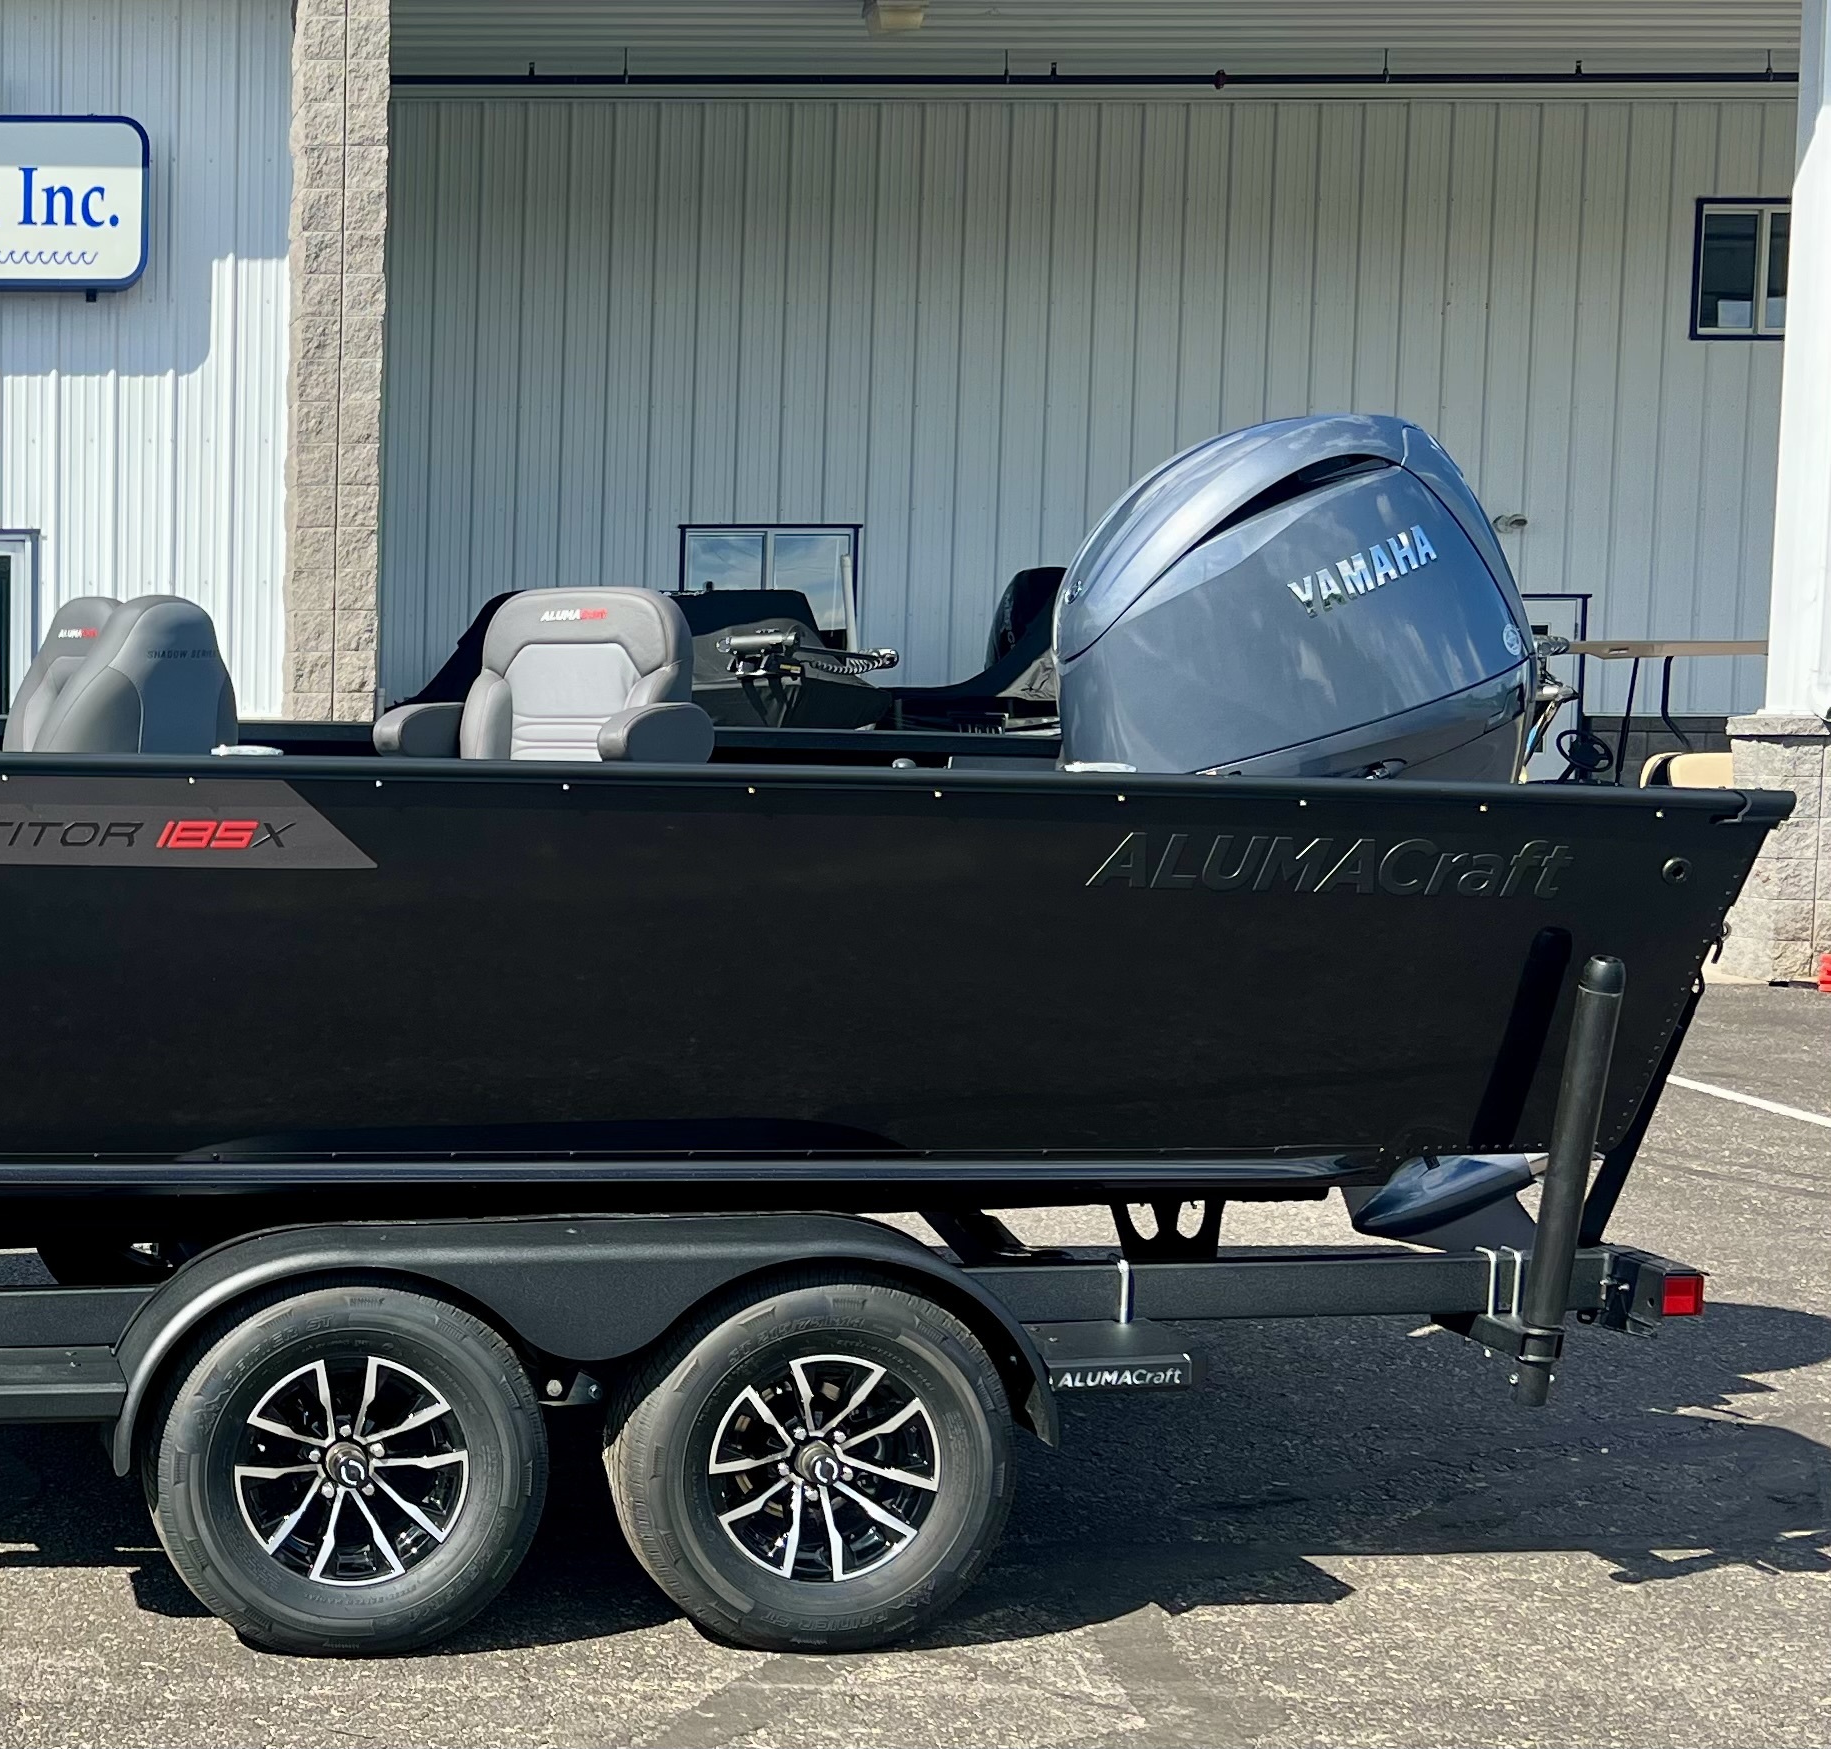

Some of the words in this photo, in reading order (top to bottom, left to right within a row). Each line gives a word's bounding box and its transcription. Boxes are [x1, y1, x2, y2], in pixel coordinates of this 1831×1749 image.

[17, 167, 120, 228] Inc.
[1287, 524, 1437, 618] YAMAHA
[147, 650, 188, 659] SHADOW
[156, 819, 297, 849] 185X
[1085, 831, 1574, 898] ALUMACraft
[303, 1313, 335, 1331] ST
[1058, 1368, 1182, 1387] ALUMACraft
